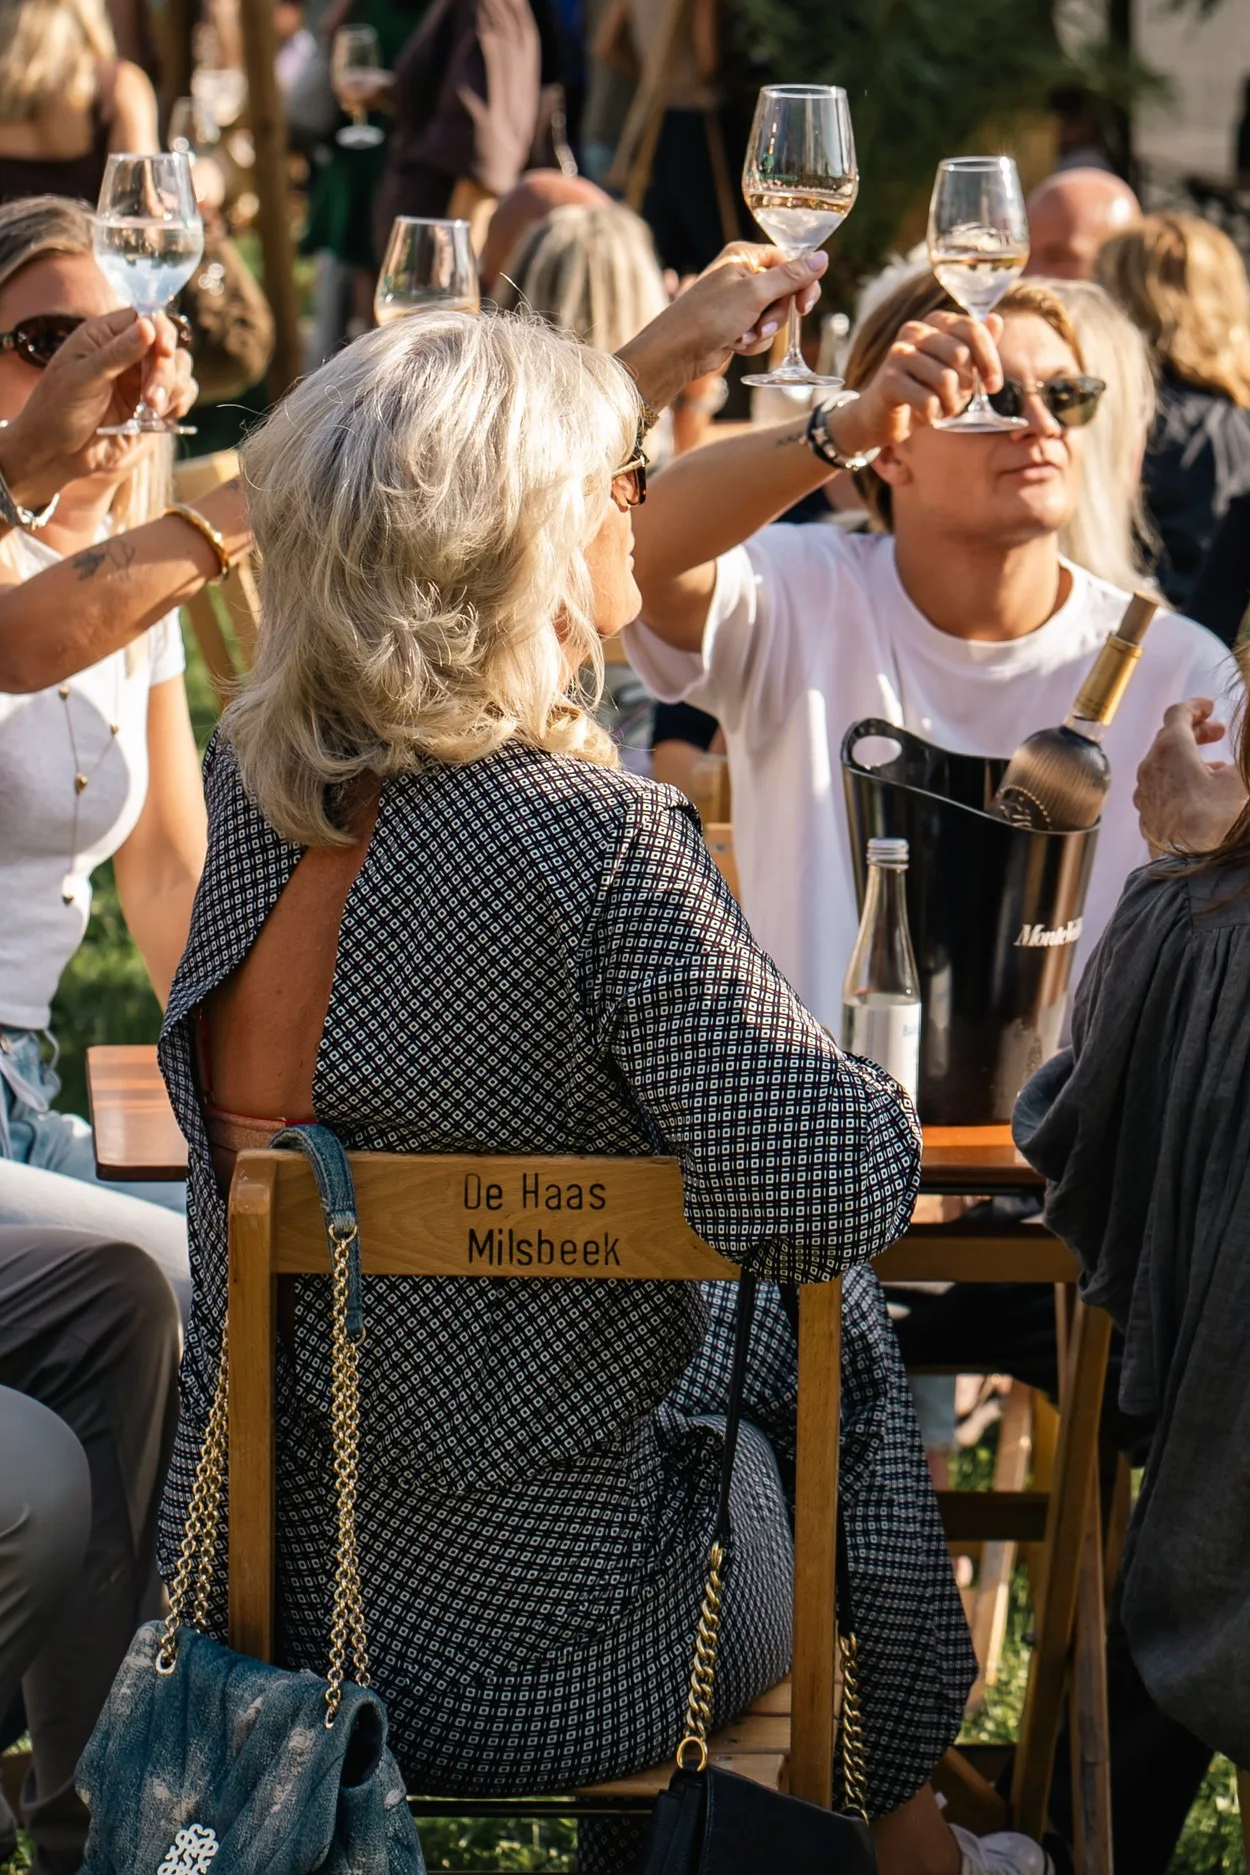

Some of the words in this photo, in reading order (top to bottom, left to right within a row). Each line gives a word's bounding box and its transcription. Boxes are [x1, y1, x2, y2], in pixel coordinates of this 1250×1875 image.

[464, 1172, 503, 1210] De
[522, 1172, 607, 1210] Haas
[468, 1228, 620, 1266] Milsbeek
